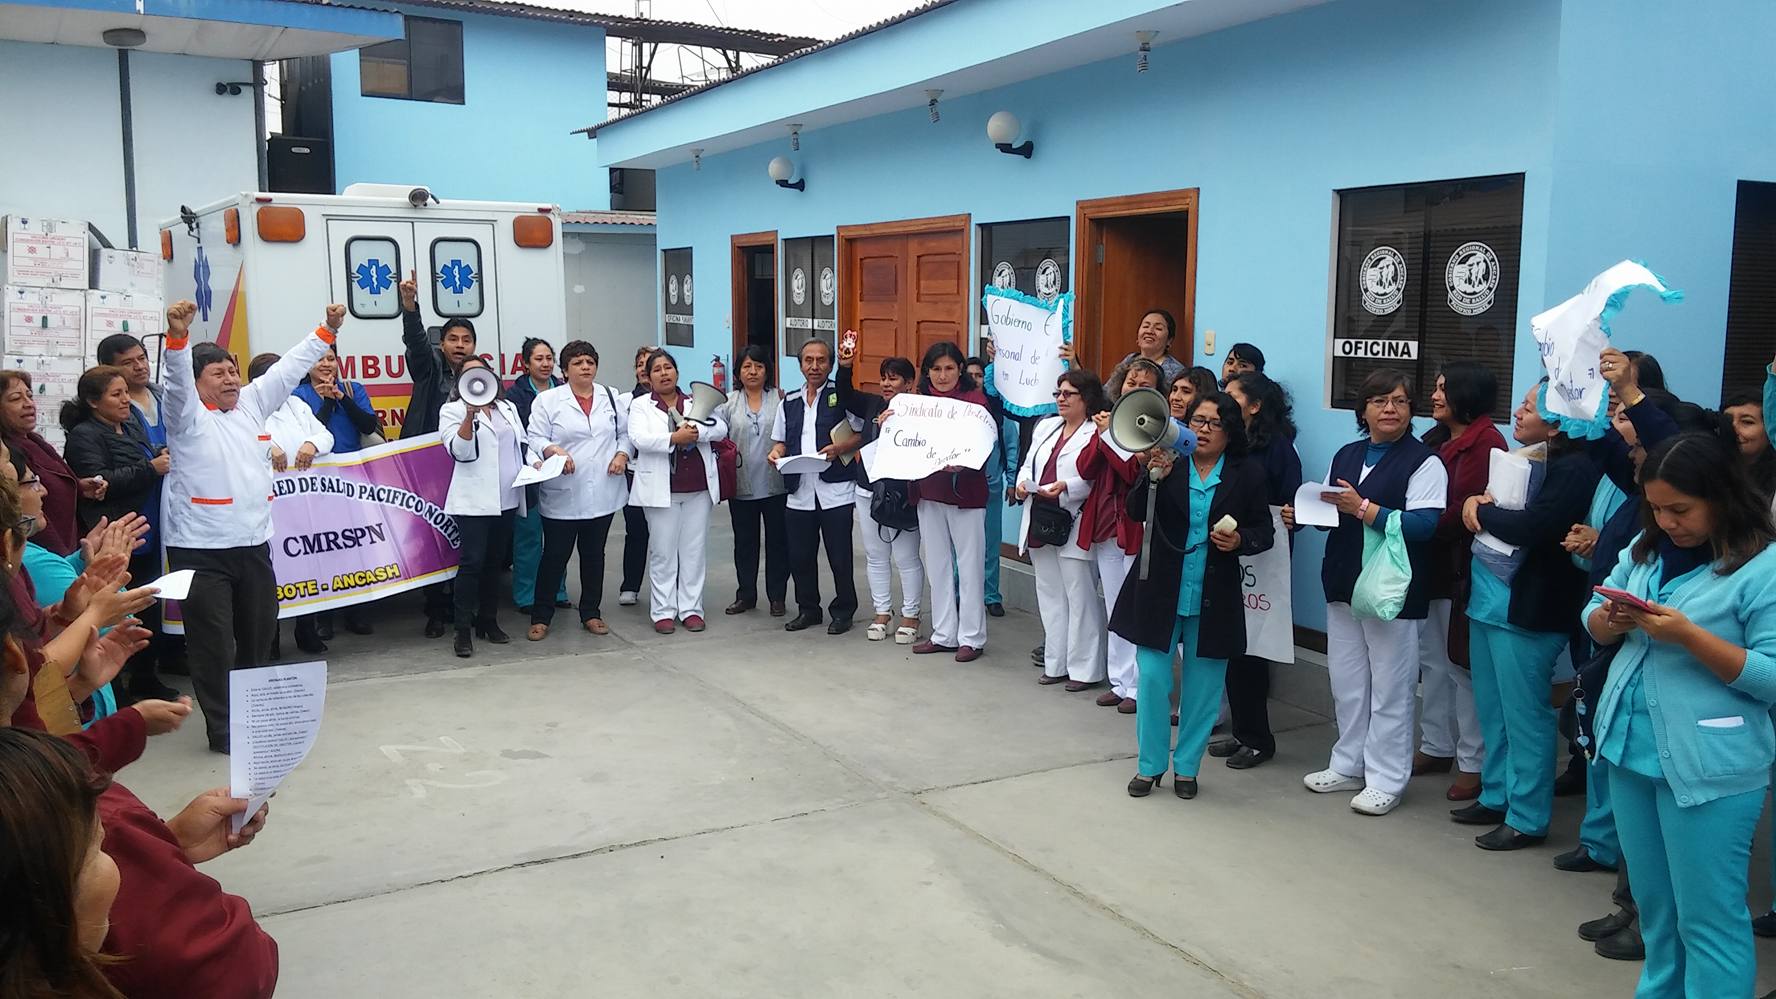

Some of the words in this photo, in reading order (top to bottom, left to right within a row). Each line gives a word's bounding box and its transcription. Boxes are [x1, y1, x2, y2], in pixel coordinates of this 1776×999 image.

[991, 299, 1032, 332] Gobierno
[1341, 340, 1412, 358] OFICINA
[897, 400, 943, 418] Sindicato
[947, 405, 957, 420] de
[926, 447, 937, 459] de
[300, 476, 318, 493] DE
[321, 477, 355, 498] SALUD
[358, 484, 423, 513] PACIFICO
[424, 505, 461, 547] NORTE
[283, 523, 386, 558] CMRSPN
[332, 563, 400, 591] ANCASH
